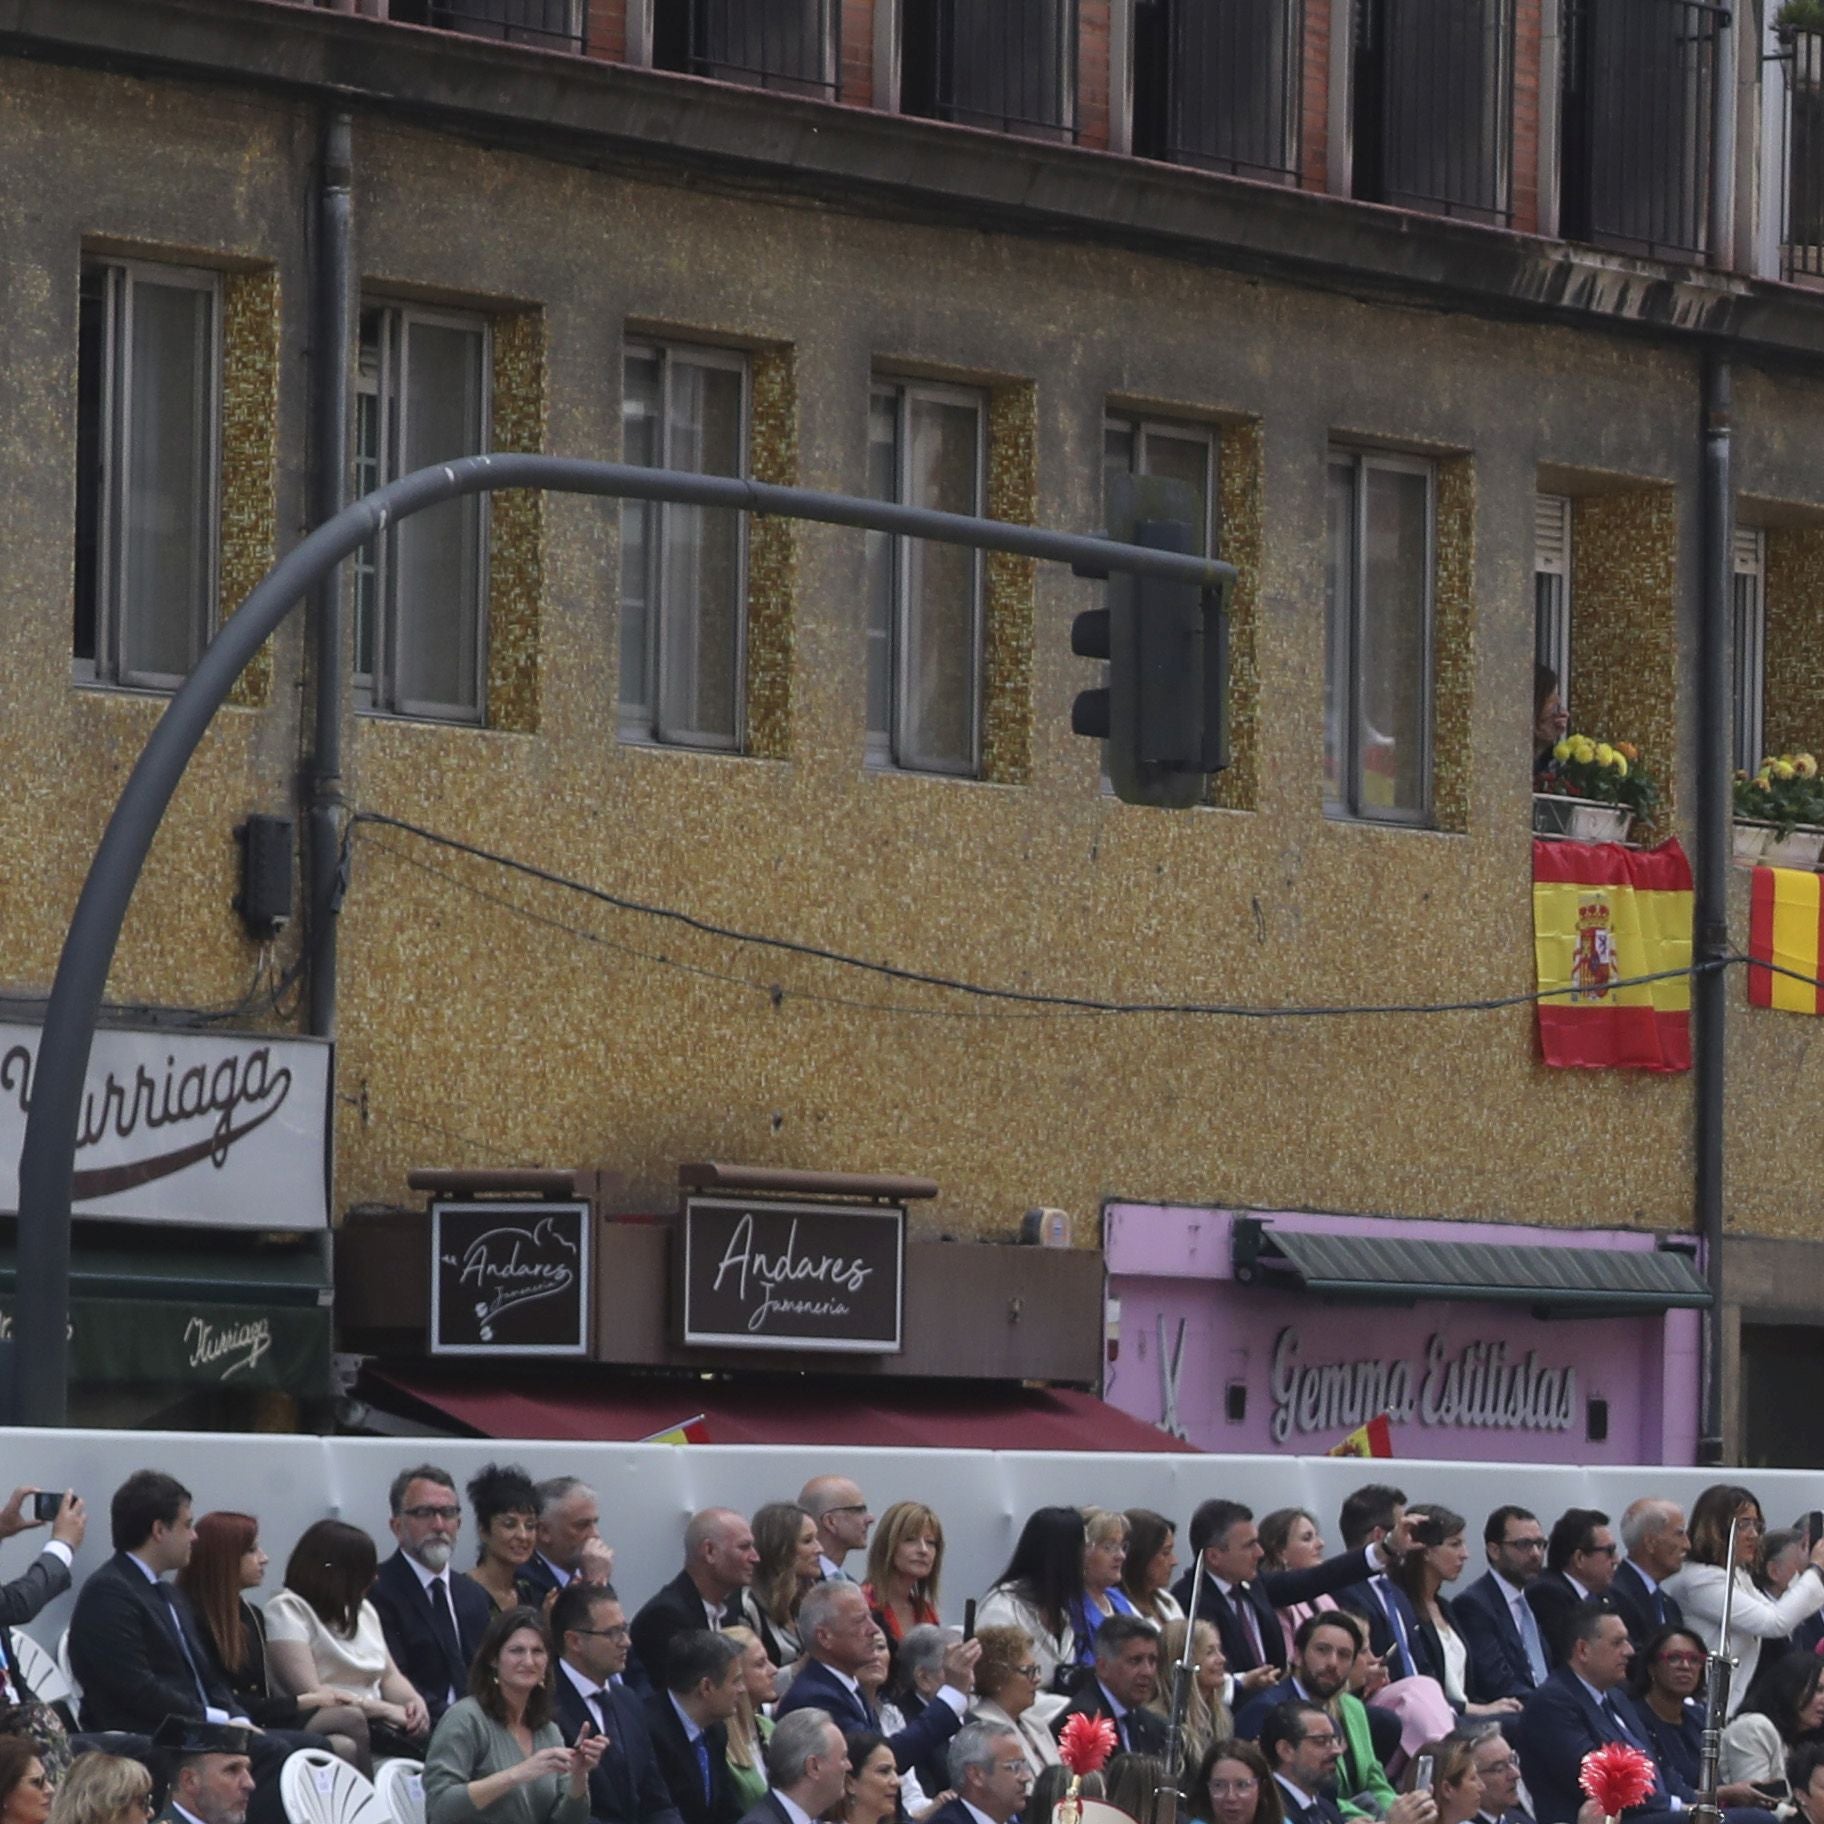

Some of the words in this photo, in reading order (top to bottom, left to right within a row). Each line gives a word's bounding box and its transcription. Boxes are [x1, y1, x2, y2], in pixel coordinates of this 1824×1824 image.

[459, 1240, 572, 1288] Andares
[713, 1213, 873, 1300] Andares
[1270, 1324, 1412, 1444] Gemma
[1419, 1332, 1577, 1430] Estilistas
